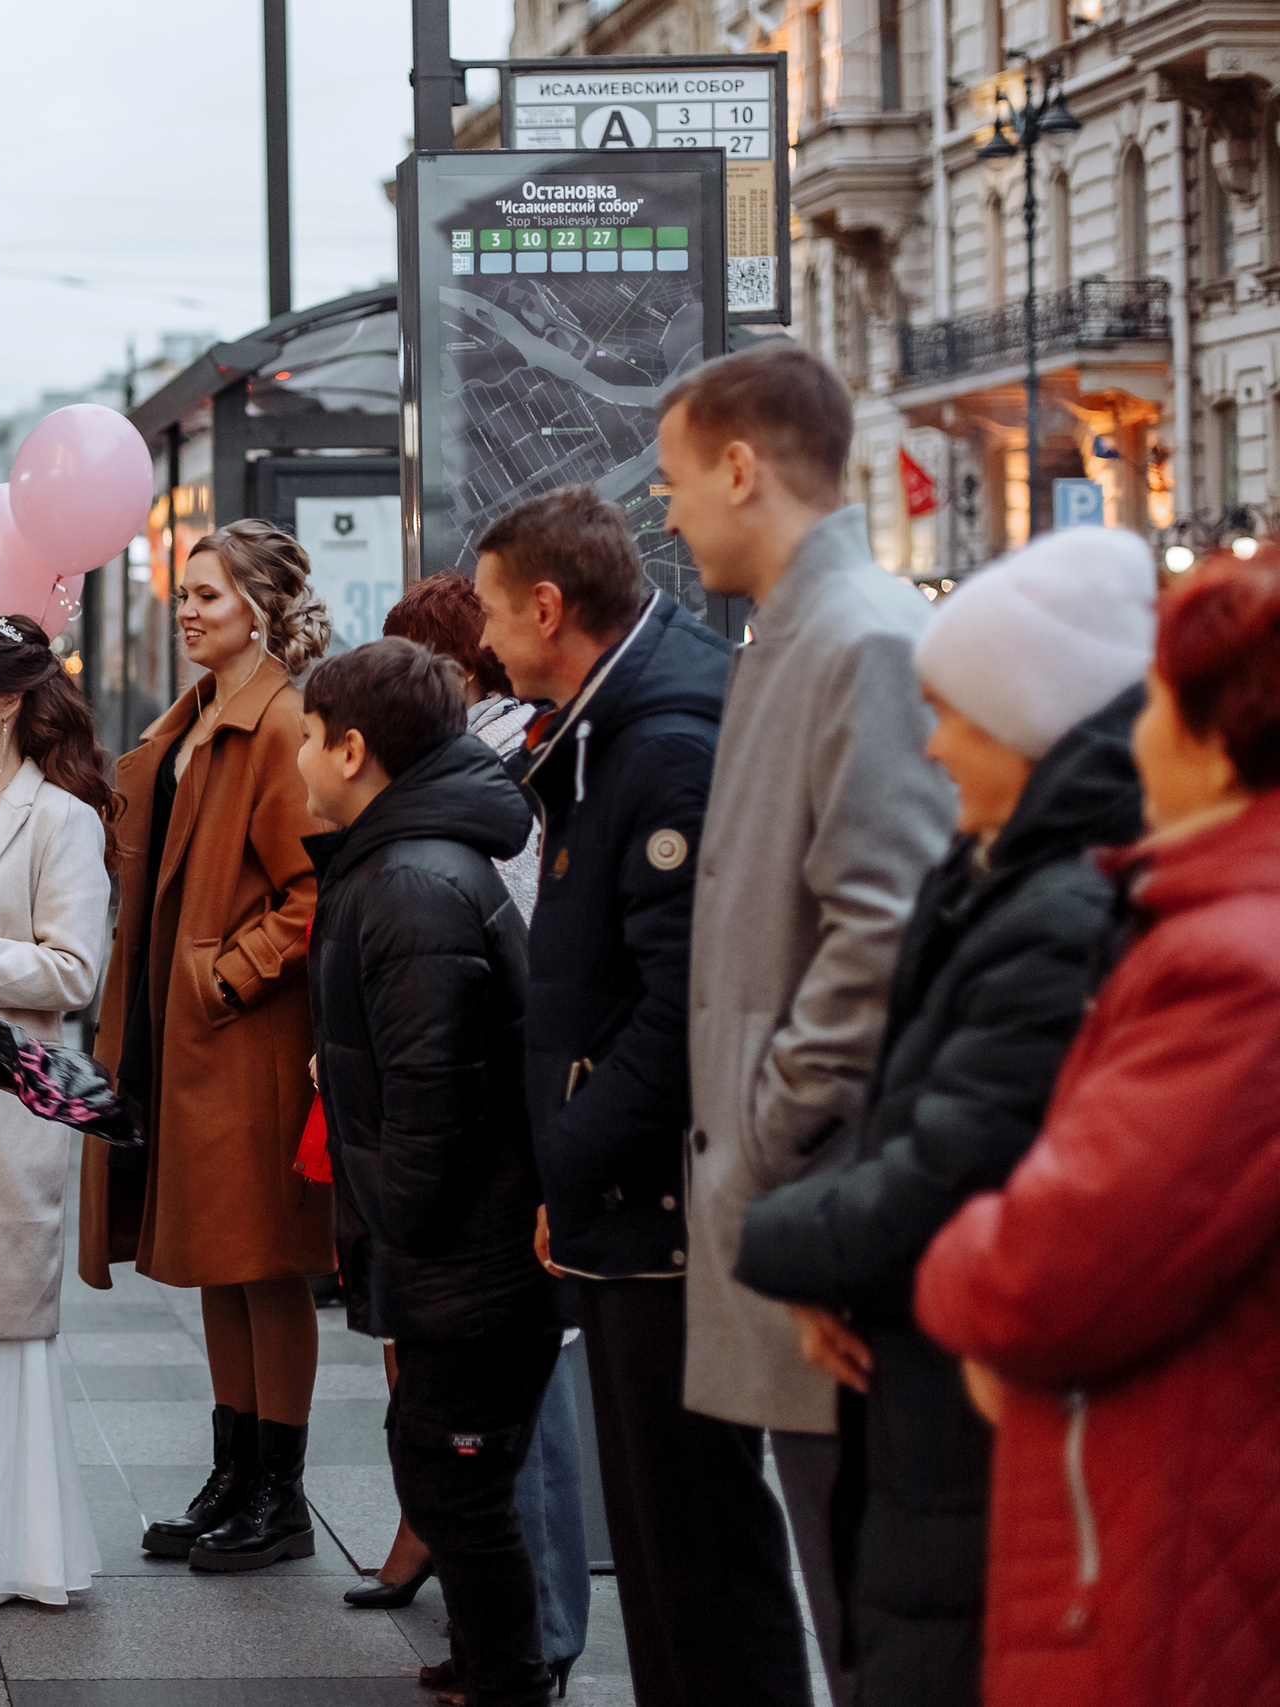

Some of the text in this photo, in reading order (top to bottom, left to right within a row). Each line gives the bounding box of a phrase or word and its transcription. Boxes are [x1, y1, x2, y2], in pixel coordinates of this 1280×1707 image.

[539, 78, 745, 96] ИСААКИЕВСКИЙ СОБОР
[679, 107, 690, 125] 3
[730, 106, 754, 124] 10
[730, 136, 754, 153] 27
[522, 181, 617, 201] Остановка
[506, 215, 531, 228] Stop
[491, 231, 611, 247] 3 10 22 27
[1071, 484, 1098, 527] P
